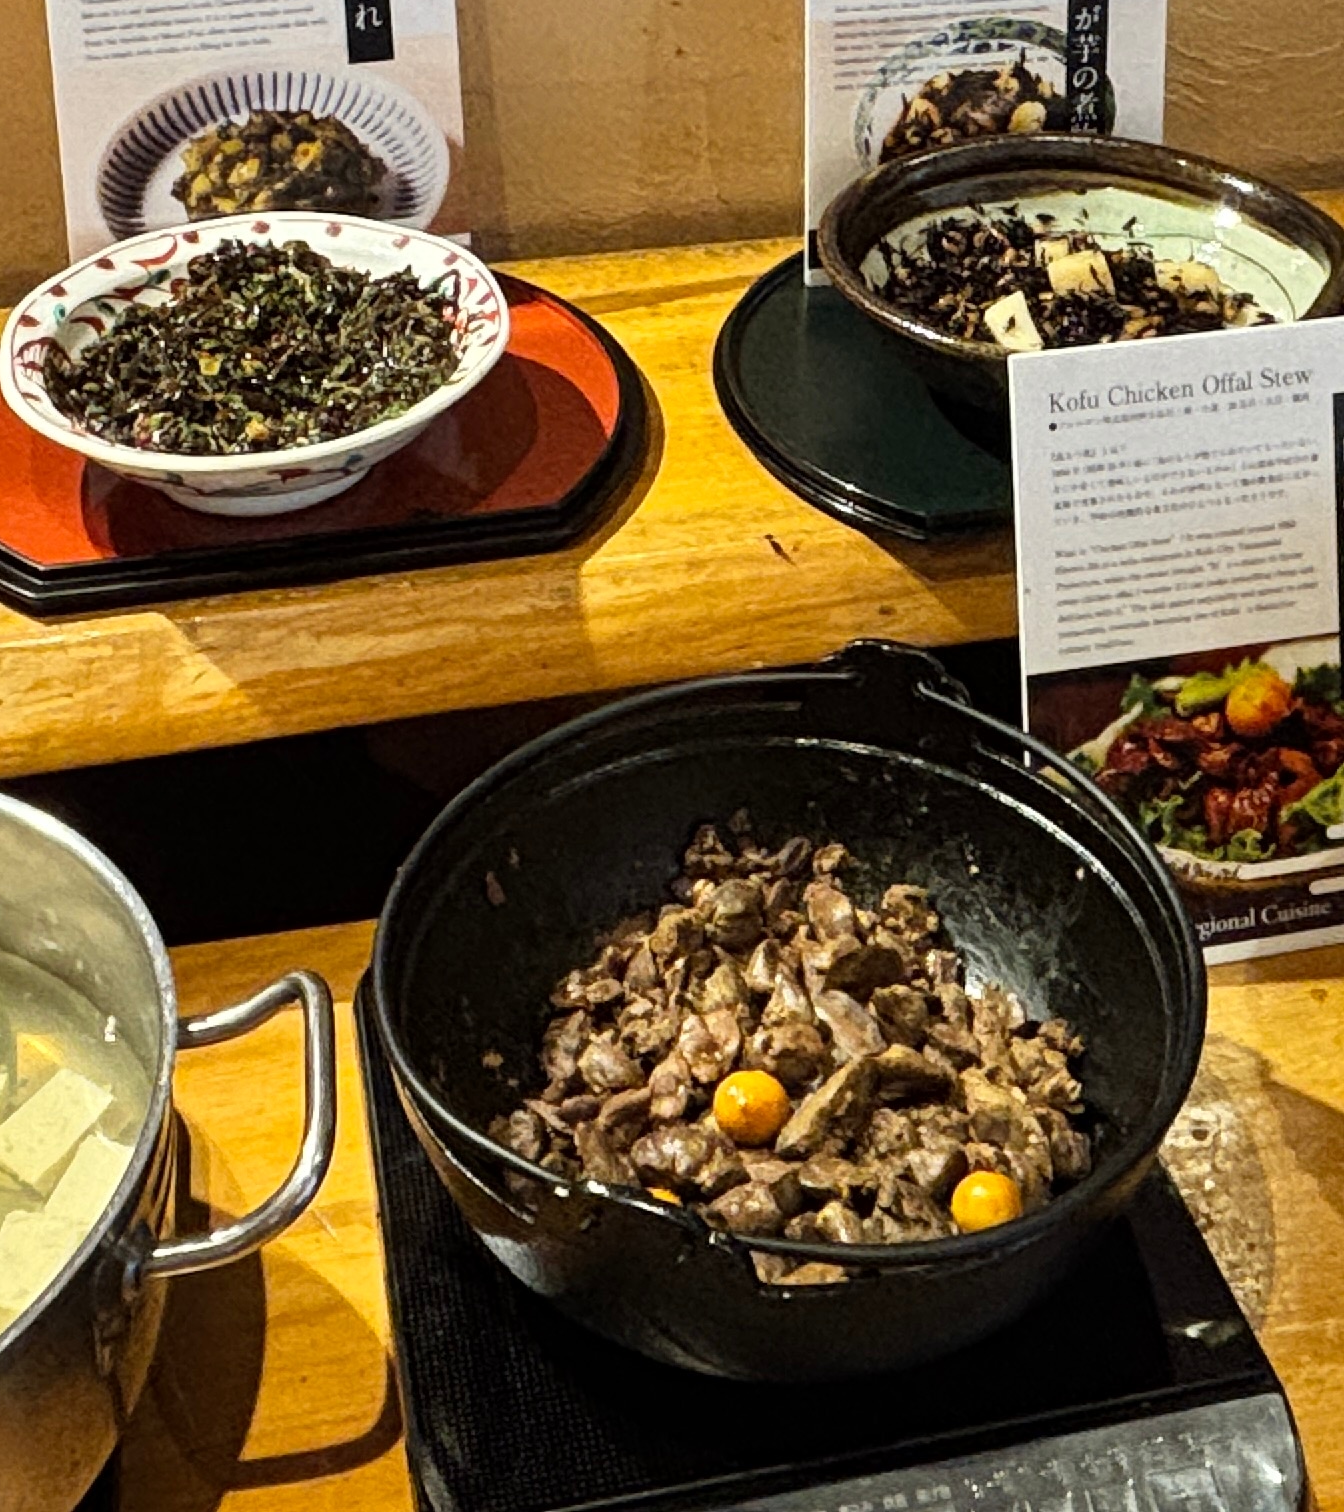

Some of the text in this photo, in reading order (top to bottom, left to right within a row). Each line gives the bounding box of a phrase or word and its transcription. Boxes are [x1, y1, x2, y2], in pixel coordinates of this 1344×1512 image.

[1049, 389, 1100, 414] Kofu
[1108, 381, 1194, 407] Chicken
[1202, 371, 1253, 396] Offal
[1260, 366, 1312, 389] Stew
[1195, 901, 1332, 941] gional Cuisine
